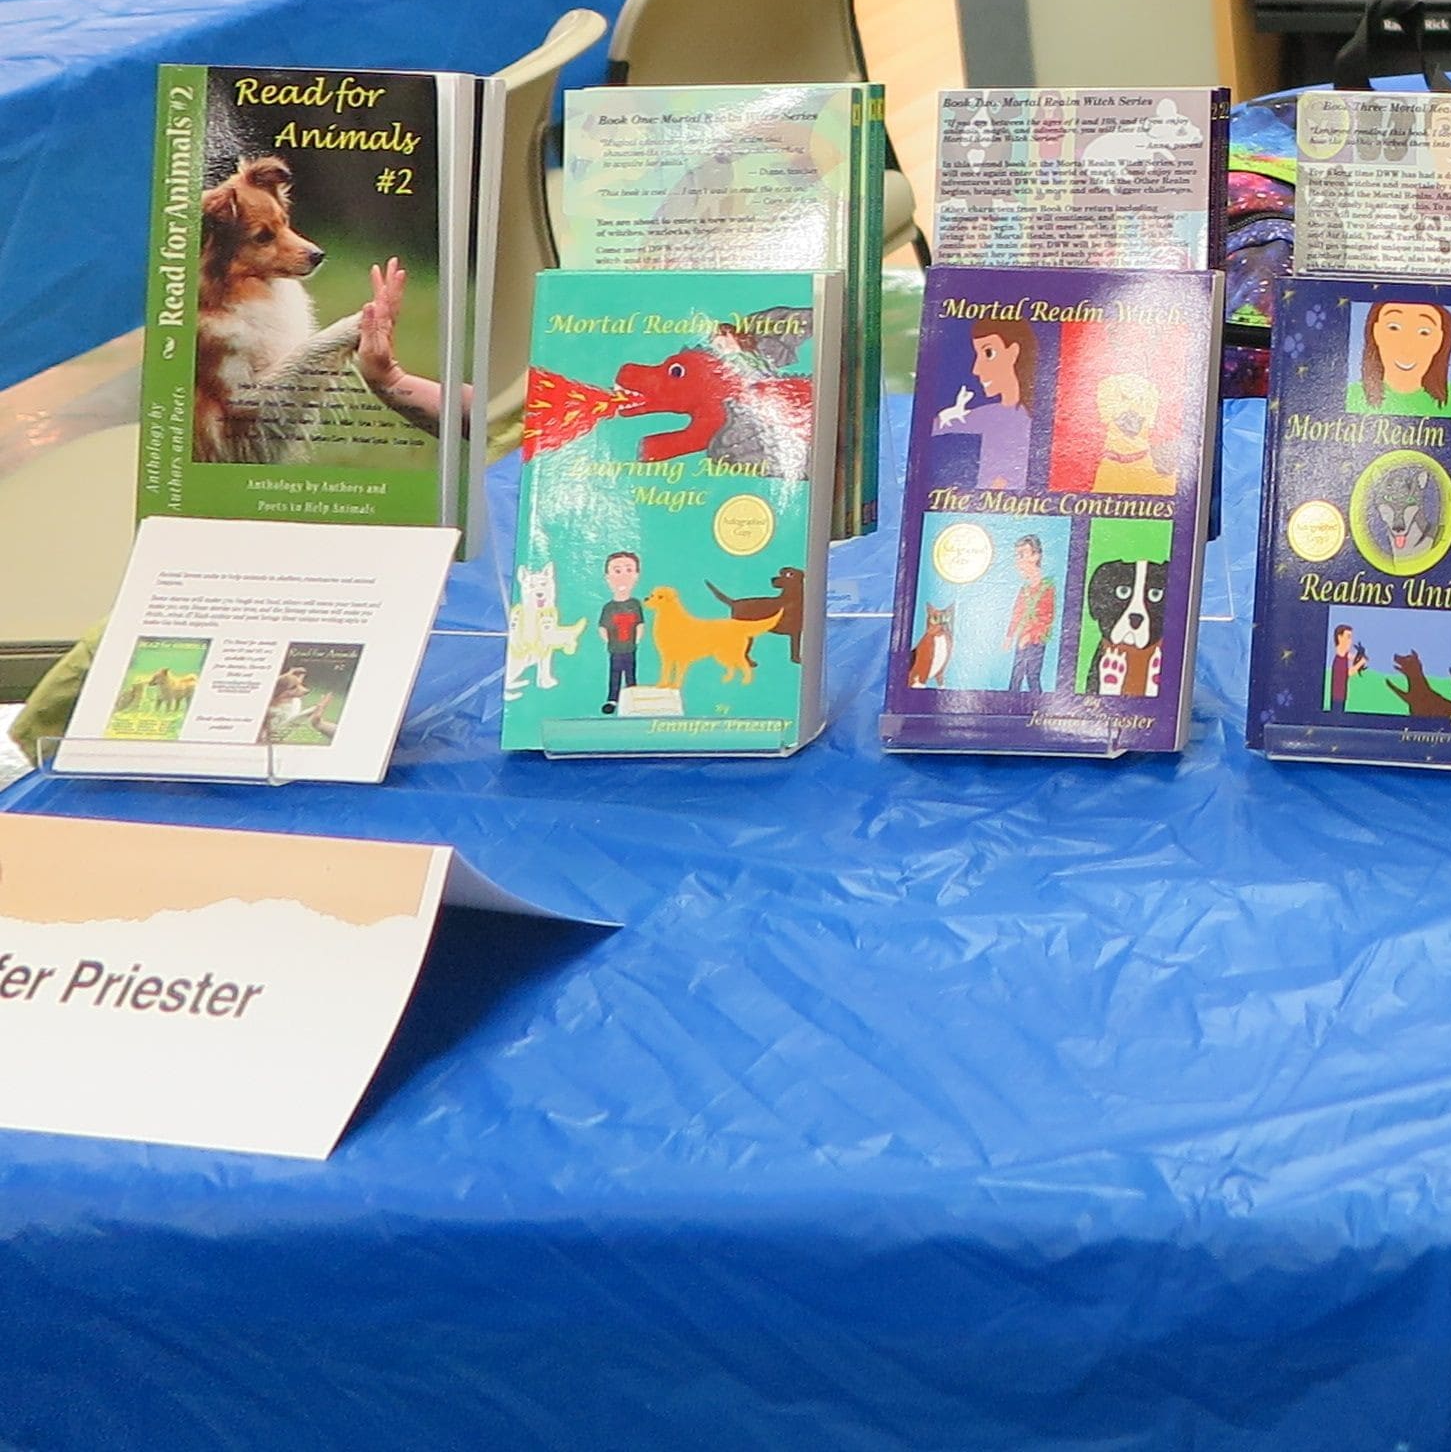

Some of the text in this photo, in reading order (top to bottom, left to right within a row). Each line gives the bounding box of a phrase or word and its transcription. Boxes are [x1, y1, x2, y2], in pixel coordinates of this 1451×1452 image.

[1424, 18, 1450, 32] Rick
[234, 77, 387, 114] Read for
[274, 122, 422, 155] Animals
[375, 168, 414, 196] #2
[158, 86, 194, 327] Read for Animals #2
[545, 311, 808, 335] Mortal Realm Witch:
[938, 297, 1031, 323] Mortal
[1029, 299, 1105, 324] Realm
[1284, 413, 1367, 443] Mortal
[1373, 415, 1446, 448] Realm
[566, 452, 770, 483] Learning About
[248, 479, 387, 494] Anthology by Authors and
[631, 484, 709, 511] Magic
[290, 503, 301, 512] to
[304, 502, 329, 515] Help
[332, 503, 376, 514] Animals
[927, 487, 1177, 519] The Magic Continues
[1298, 572, 1397, 607] Realms
[648, 718, 792, 734] Jennifer Priester
[58, 959, 265, 1019] Priester
